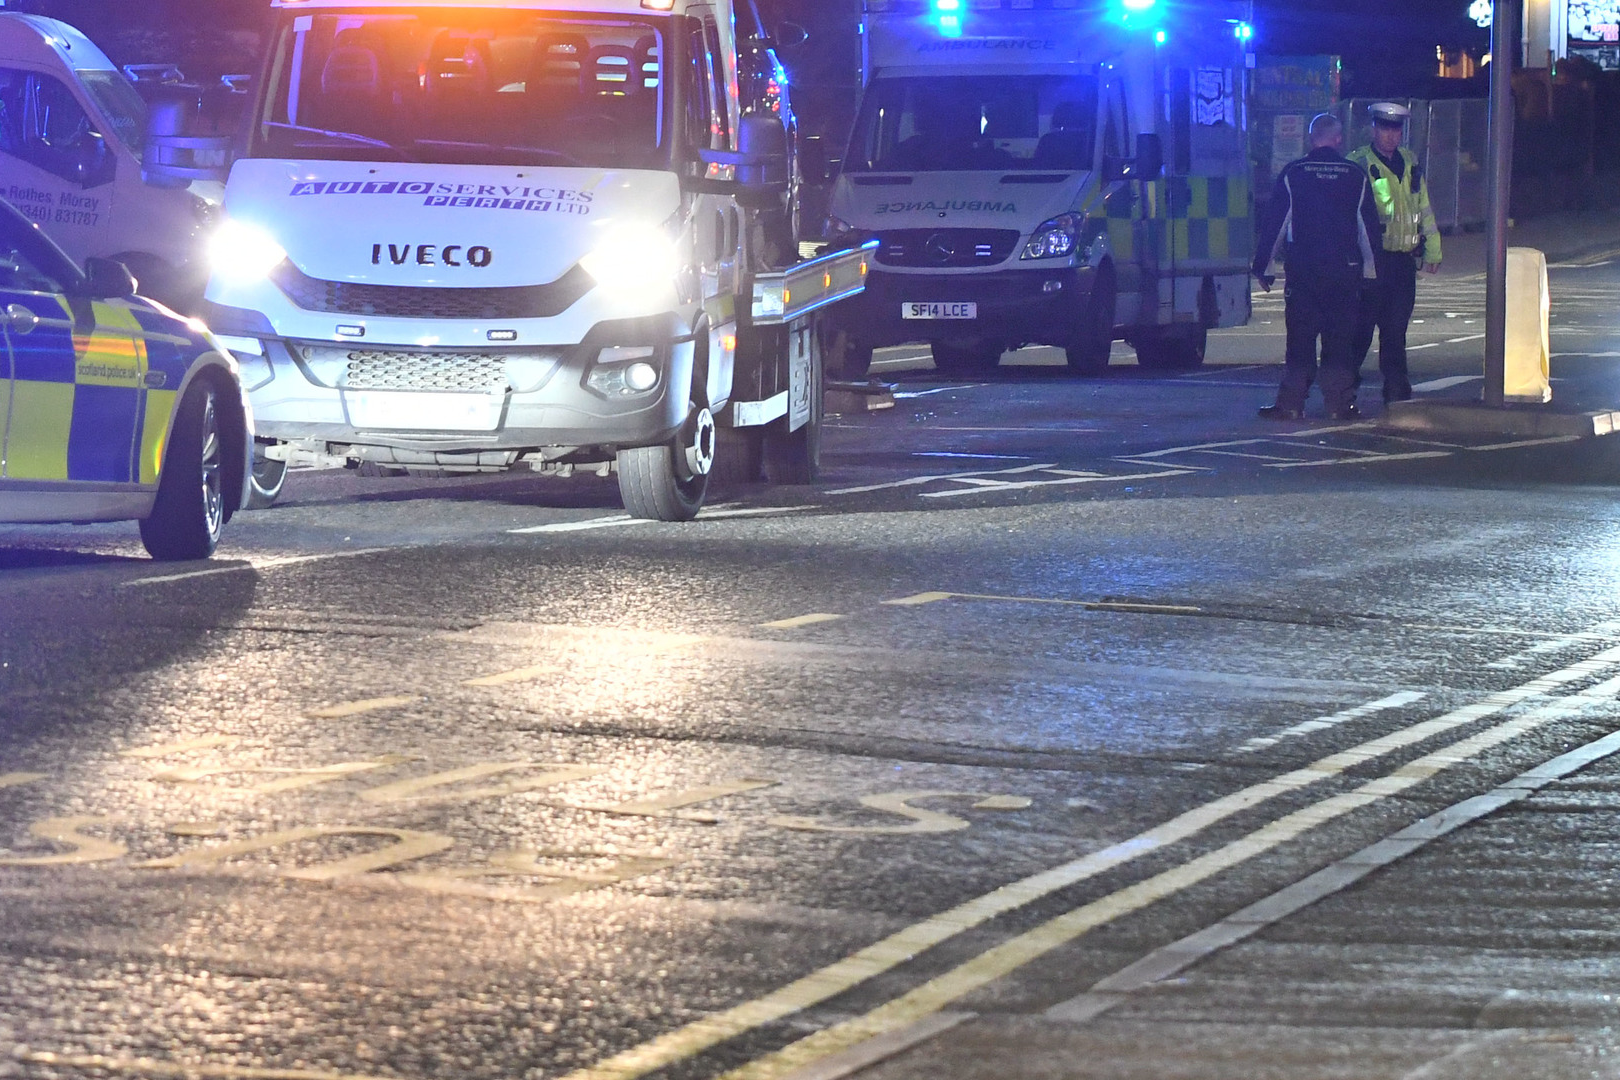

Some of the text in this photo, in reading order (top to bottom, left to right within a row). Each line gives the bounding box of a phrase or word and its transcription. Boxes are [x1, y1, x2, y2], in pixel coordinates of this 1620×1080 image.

[915, 39, 1057, 53] AMBULANCE
[1315, 172, 1338, 180] Service
[60, 191, 100, 212] Moray
[426, 196, 590, 216] PERTH LTD
[55, 208, 99, 226] 831787
[371, 243, 493, 268] IVECO
[910, 304, 969, 317] SF14 LCE
[78, 362, 137, 380] scotland.police.uk
